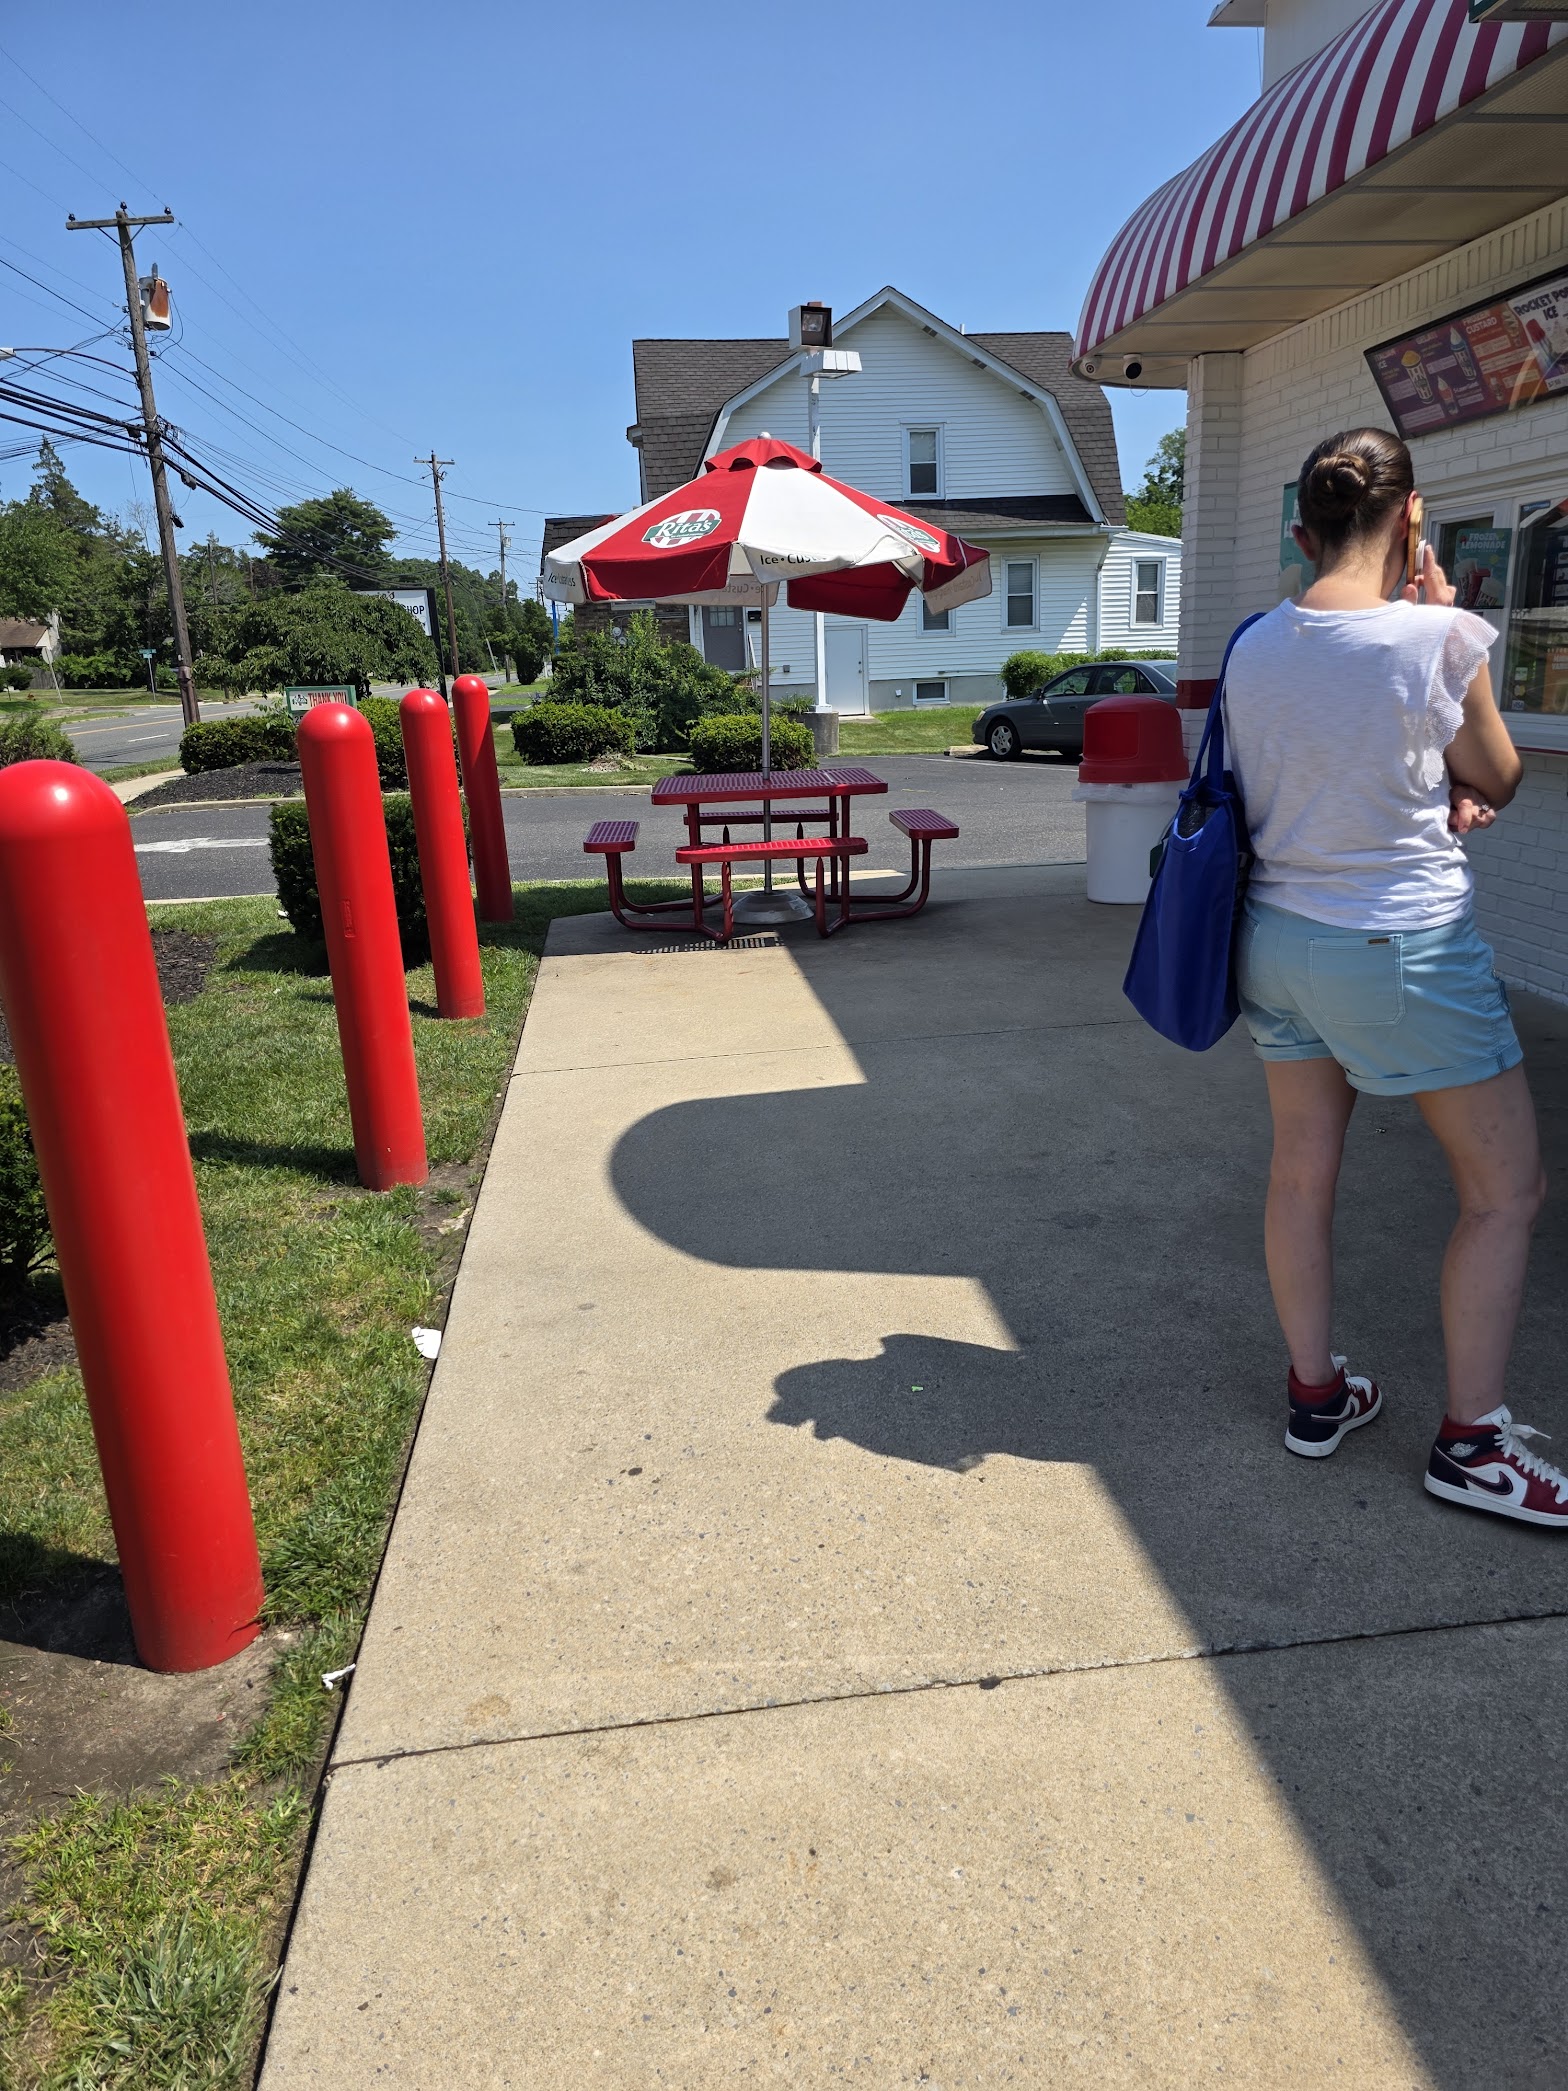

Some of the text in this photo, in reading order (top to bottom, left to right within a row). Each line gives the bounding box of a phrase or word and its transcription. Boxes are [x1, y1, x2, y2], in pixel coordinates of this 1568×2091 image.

[1513, 293, 1553, 316] ROCKET
[1543, 305, 1559, 320] ICE
[1466, 316, 1497, 335] CUSTARD
[655, 519, 713, 537] Rita's
[1468, 532, 1499, 542] FROZEN
[1461, 540, 1506, 550] LEMONADE
[760, 554, 779, 565] Ice
[308, 692, 331, 707] THANK
[333, 691, 348, 705] YOU
